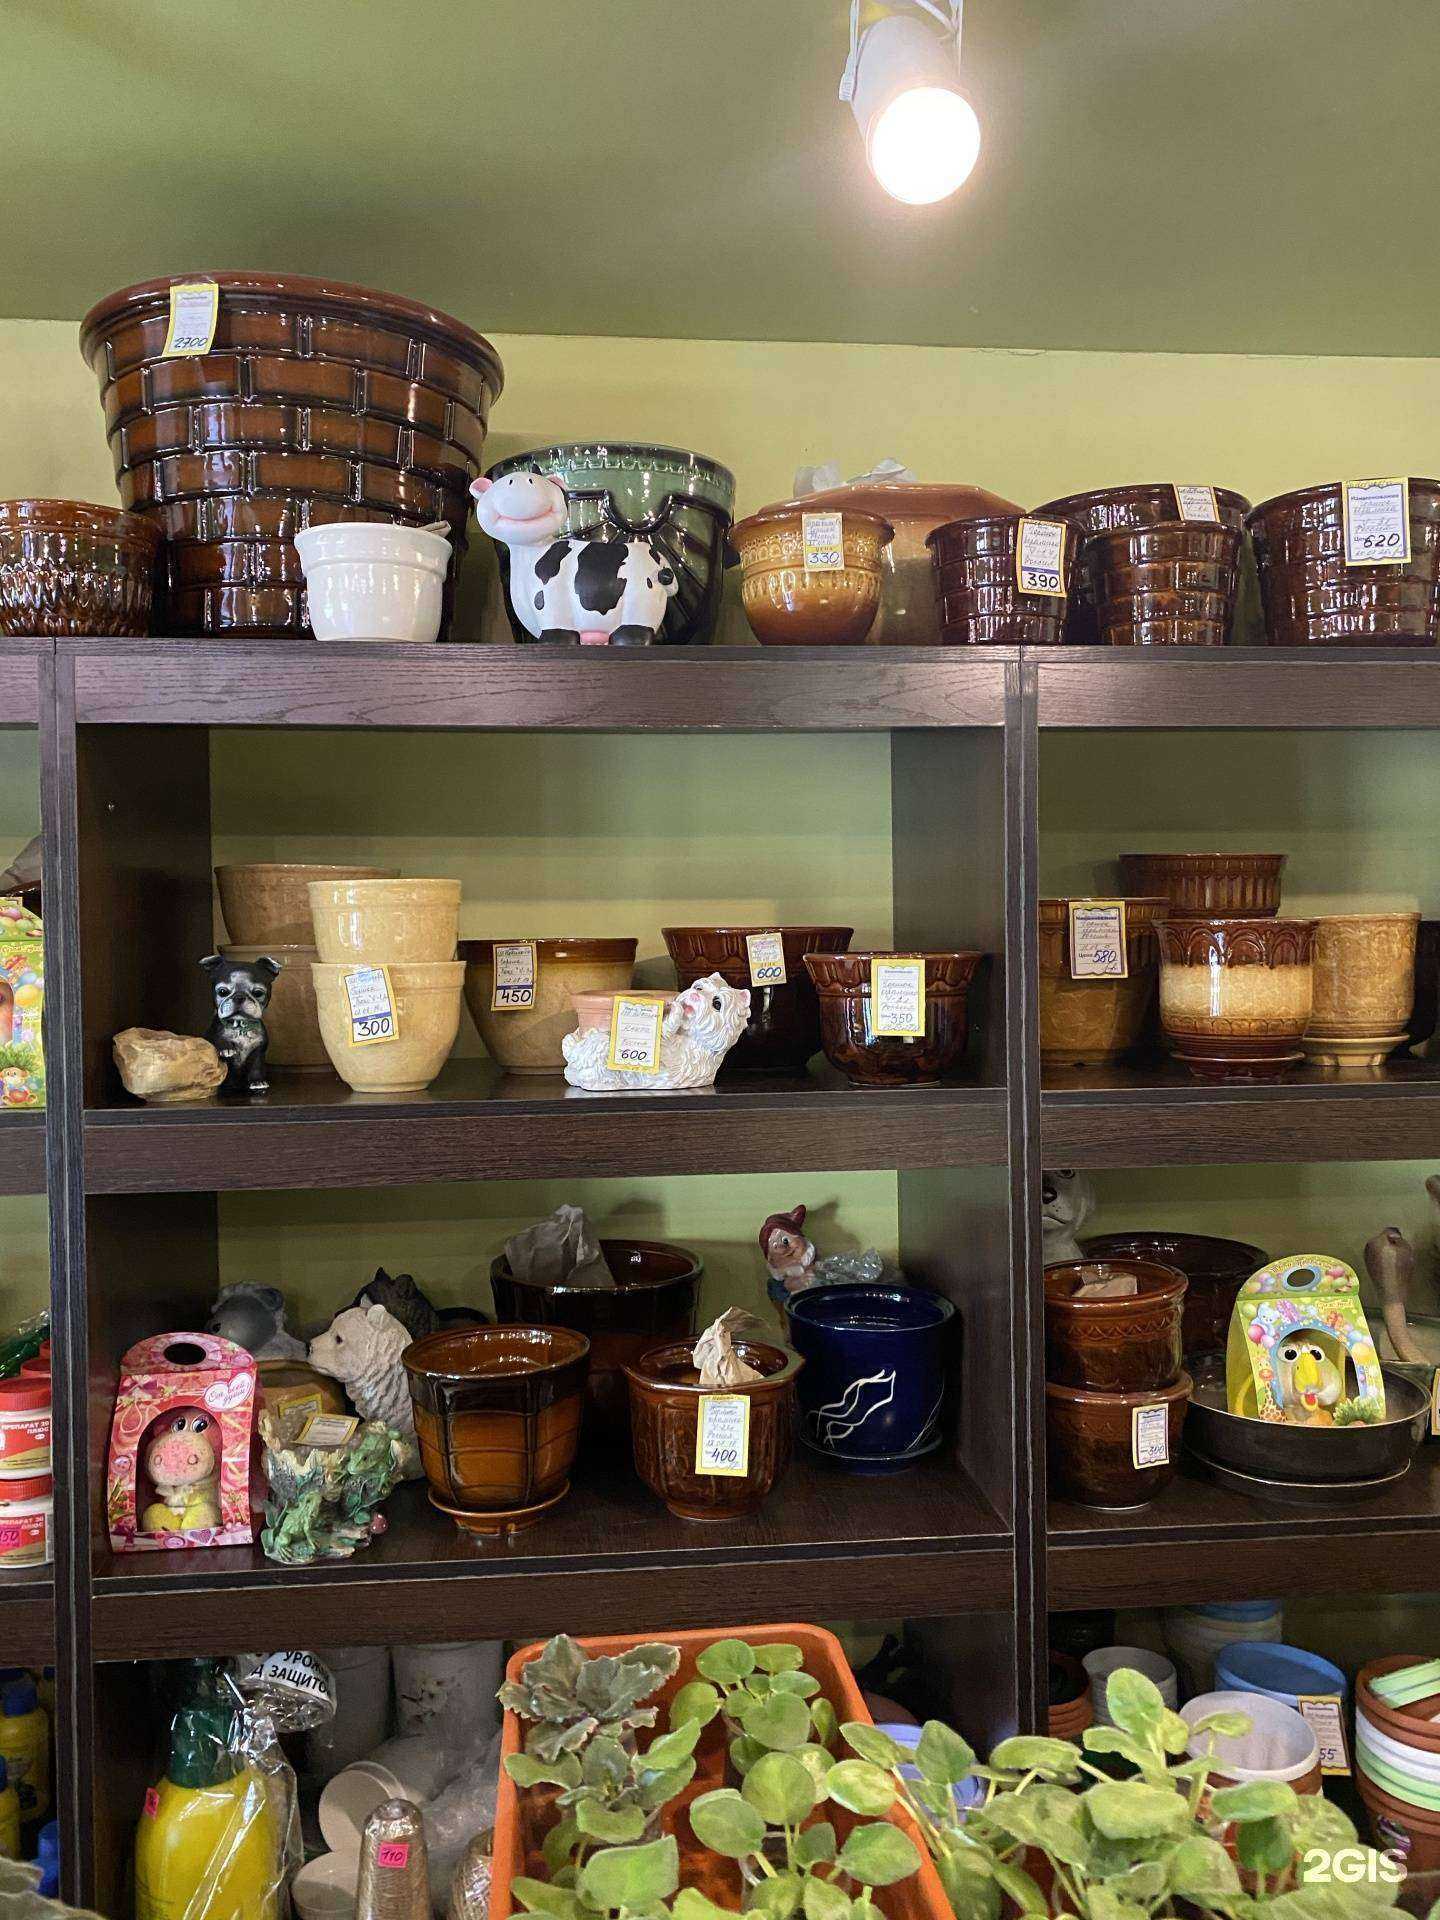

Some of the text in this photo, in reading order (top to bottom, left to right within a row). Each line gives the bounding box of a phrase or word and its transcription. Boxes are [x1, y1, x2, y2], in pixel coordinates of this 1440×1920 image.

[174, 337, 209, 349] 2700
[1363, 533, 1400, 548] 620
[809, 551, 840, 564] 330
[1027, 572, 1059, 589] 390
[1092, 949, 1117, 963] 580
[757, 966, 782, 979] 600
[501, 989, 531, 1003] 450
[890, 1013, 913, 1024] 350
[357, 1017, 390, 1037] 300
[621, 1049, 648, 1061] 600
[711, 1447, 738, 1463] 400
[269, 1665, 330, 1695] ЗАЩИТО
